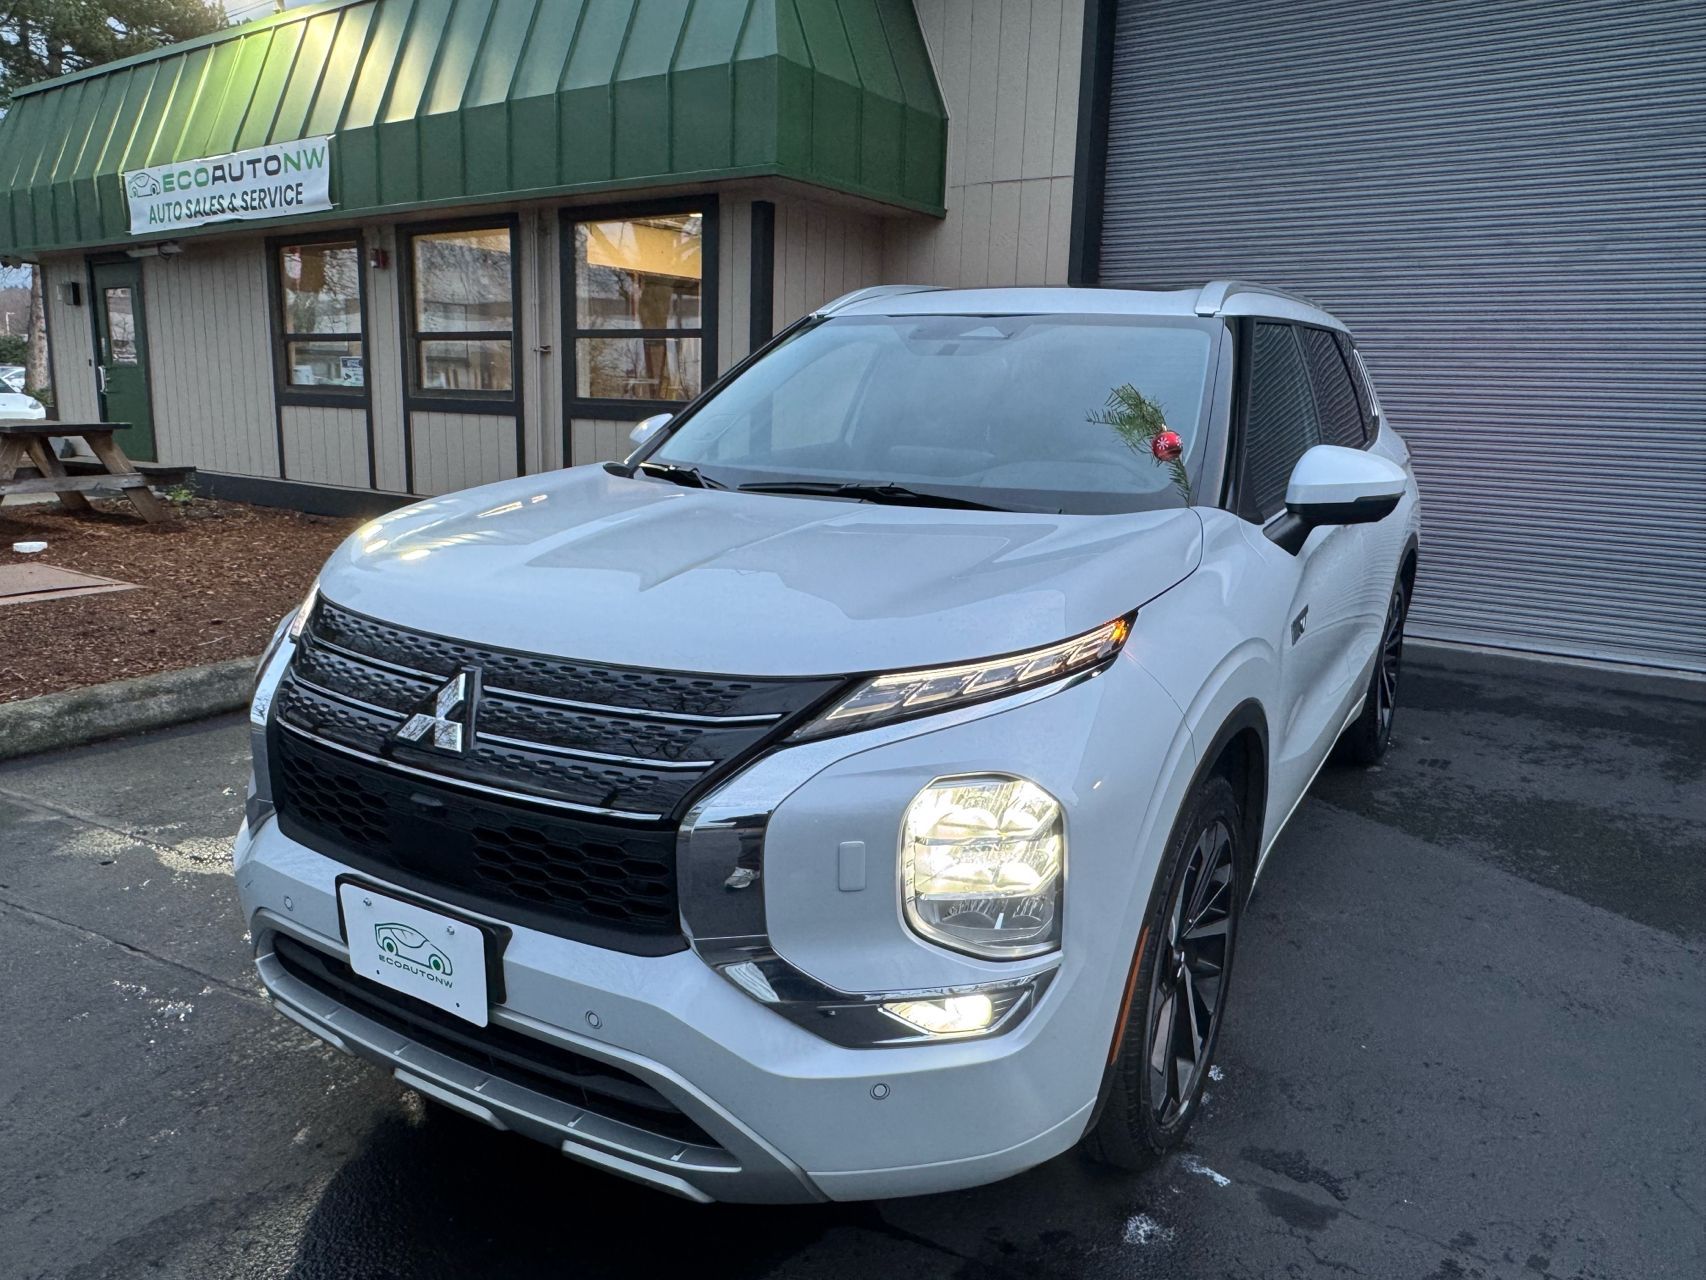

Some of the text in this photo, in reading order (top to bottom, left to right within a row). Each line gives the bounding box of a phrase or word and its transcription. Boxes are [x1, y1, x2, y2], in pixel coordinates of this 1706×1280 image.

[162, 146, 325, 193] ECOAUTONW
[149, 182, 304, 224] AUTO SALES & SERVICE
[378, 954, 453, 989] ECOAUTONW
